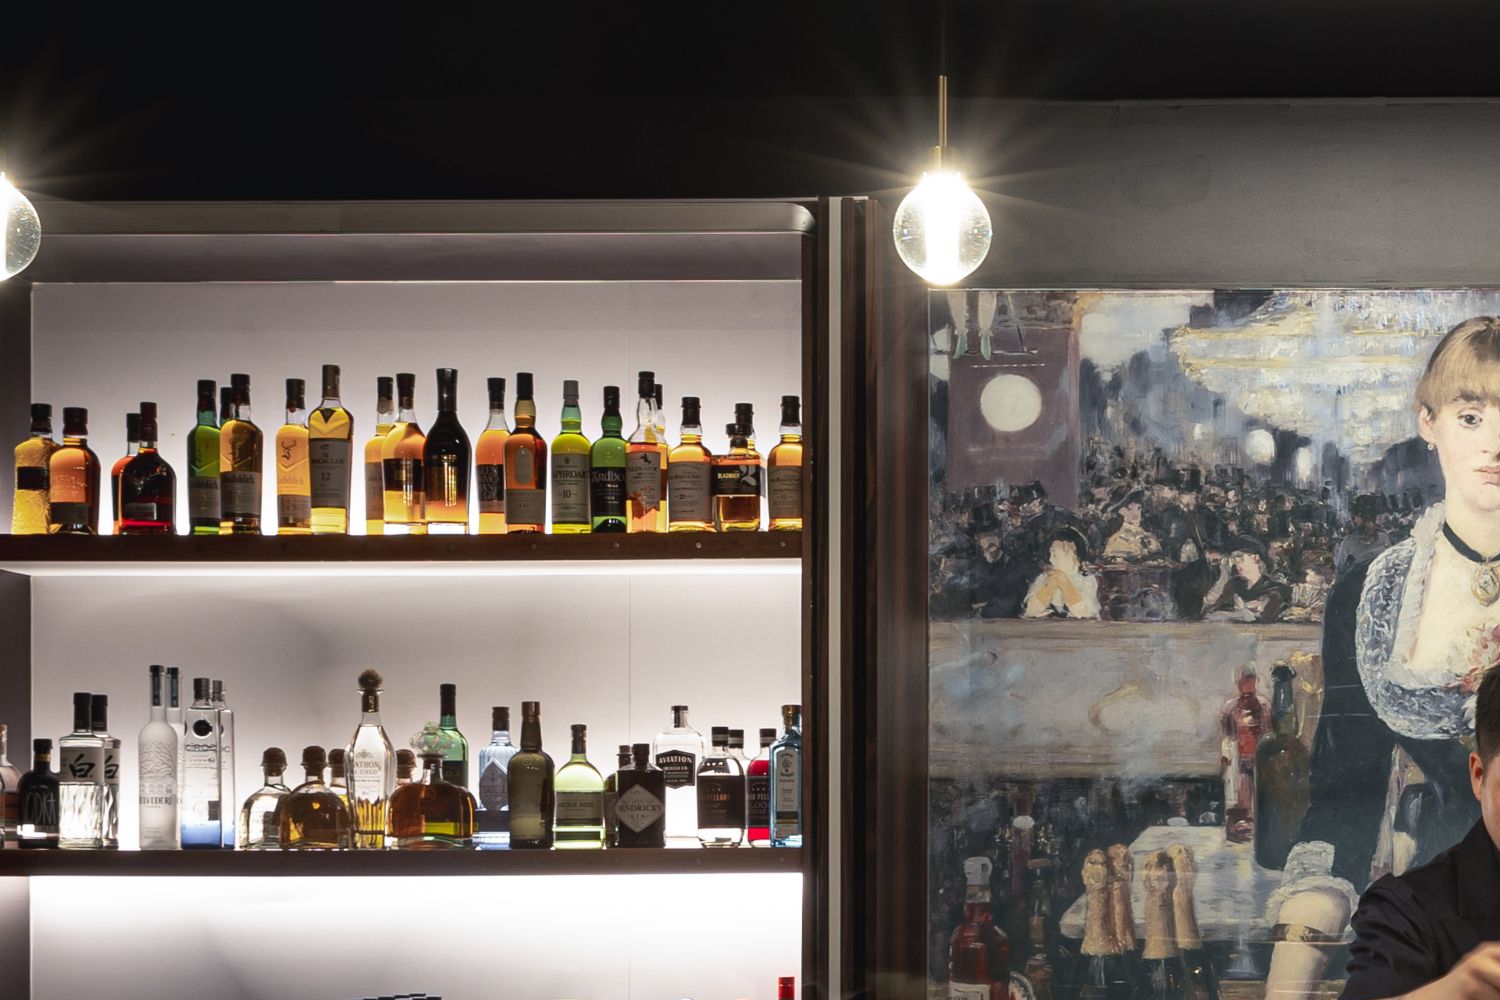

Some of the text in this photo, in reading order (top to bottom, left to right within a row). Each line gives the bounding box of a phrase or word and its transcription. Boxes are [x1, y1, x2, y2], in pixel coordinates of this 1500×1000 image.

[563, 489, 571, 498] 10
[69, 753, 96, 778] 白
[139, 796, 173, 805] ELVEDERE
